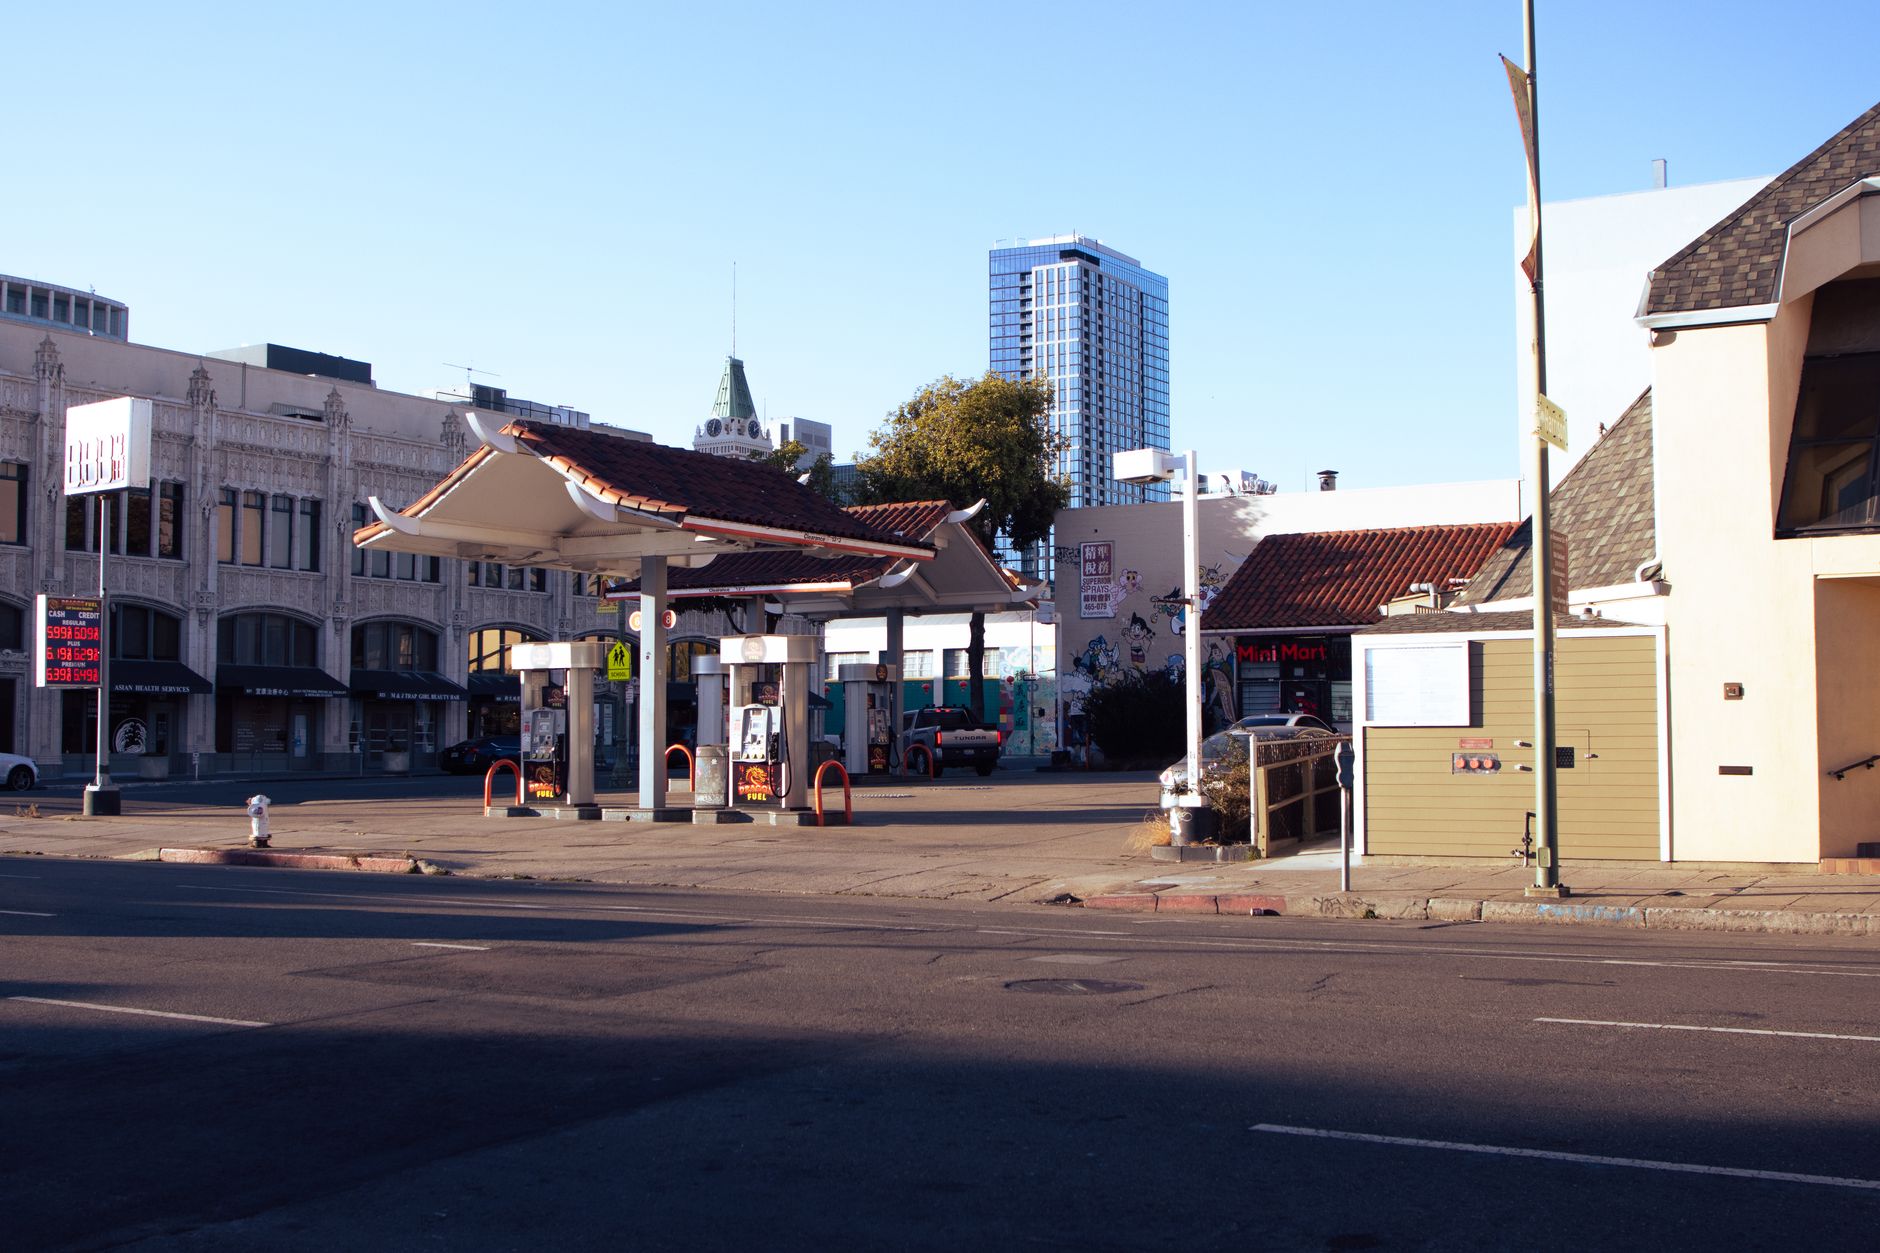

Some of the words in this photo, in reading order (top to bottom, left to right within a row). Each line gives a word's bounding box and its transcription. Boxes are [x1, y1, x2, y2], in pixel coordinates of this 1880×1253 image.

[1082, 577, 1111, 585] SUPERIOR
[1080, 585, 1109, 593] SPRAYS
[48, 610, 66, 618] CASH
[665, 615, 671, 624] 8
[1237, 645, 1277, 663] Mini
[1281, 643, 1326, 661] Mart
[135, 684, 160, 692] HEALTH
[536, 790, 554, 798] FUEL
[747, 793, 767, 801] FUEL
